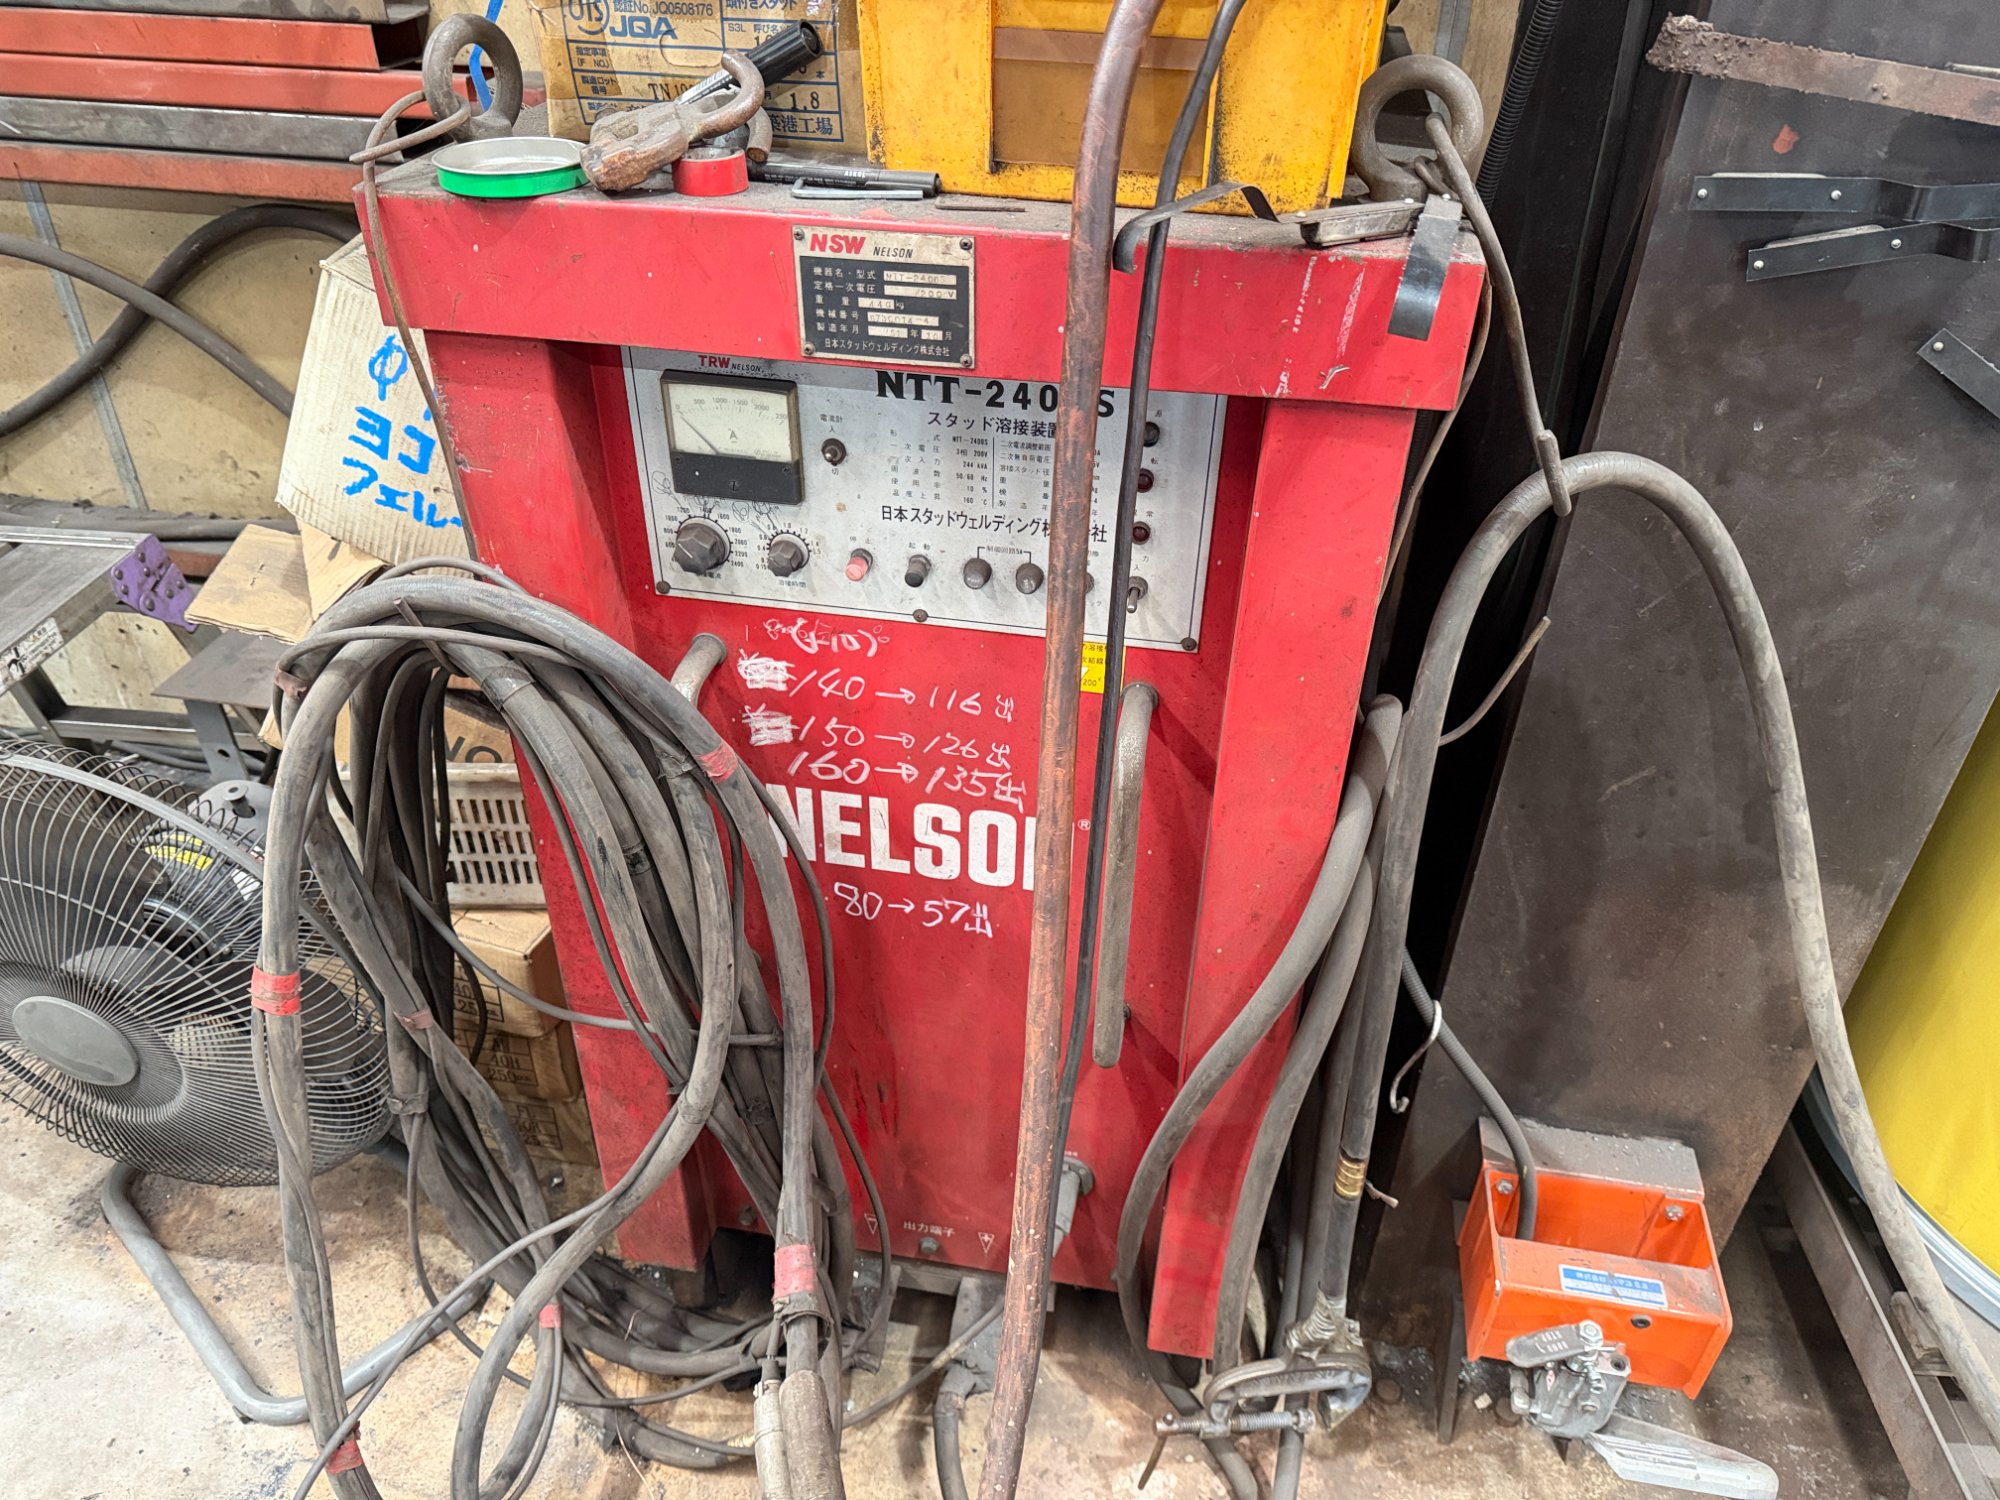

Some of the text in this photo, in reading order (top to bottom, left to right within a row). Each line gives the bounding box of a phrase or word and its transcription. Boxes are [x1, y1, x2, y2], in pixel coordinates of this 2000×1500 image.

[651, 2, 714, 17] JQ0508176
[609, 15, 678, 40] JQA
[810, 233, 914, 259] NSW NELSON
[824, 337, 950, 357] 日本スタッドウェルディング株式会社
[698, 355, 761, 374] TRW NELSON
[875, 370, 1115, 418] NTT-240S
[903, 1221, 955, 1238] 出力端子
